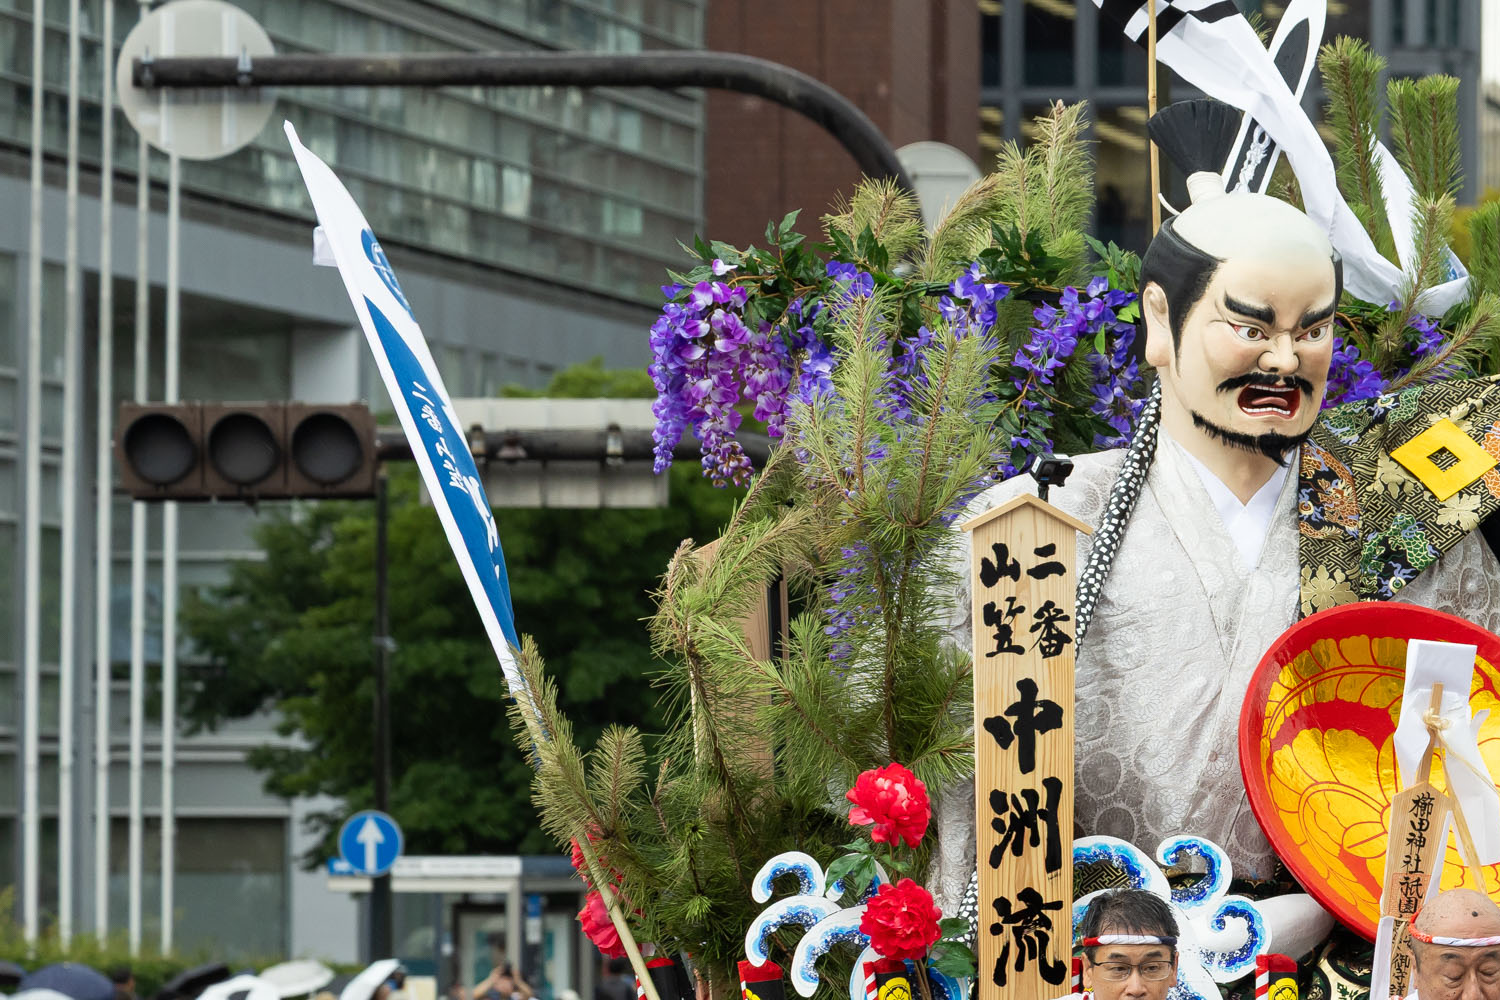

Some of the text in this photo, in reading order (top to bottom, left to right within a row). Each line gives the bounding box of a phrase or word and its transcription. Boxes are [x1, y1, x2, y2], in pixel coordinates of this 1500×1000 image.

[979, 542, 1026, 658] 山笠
[1026, 543, 1073, 659] 二番
[983, 678, 1067, 988] 中洲流
